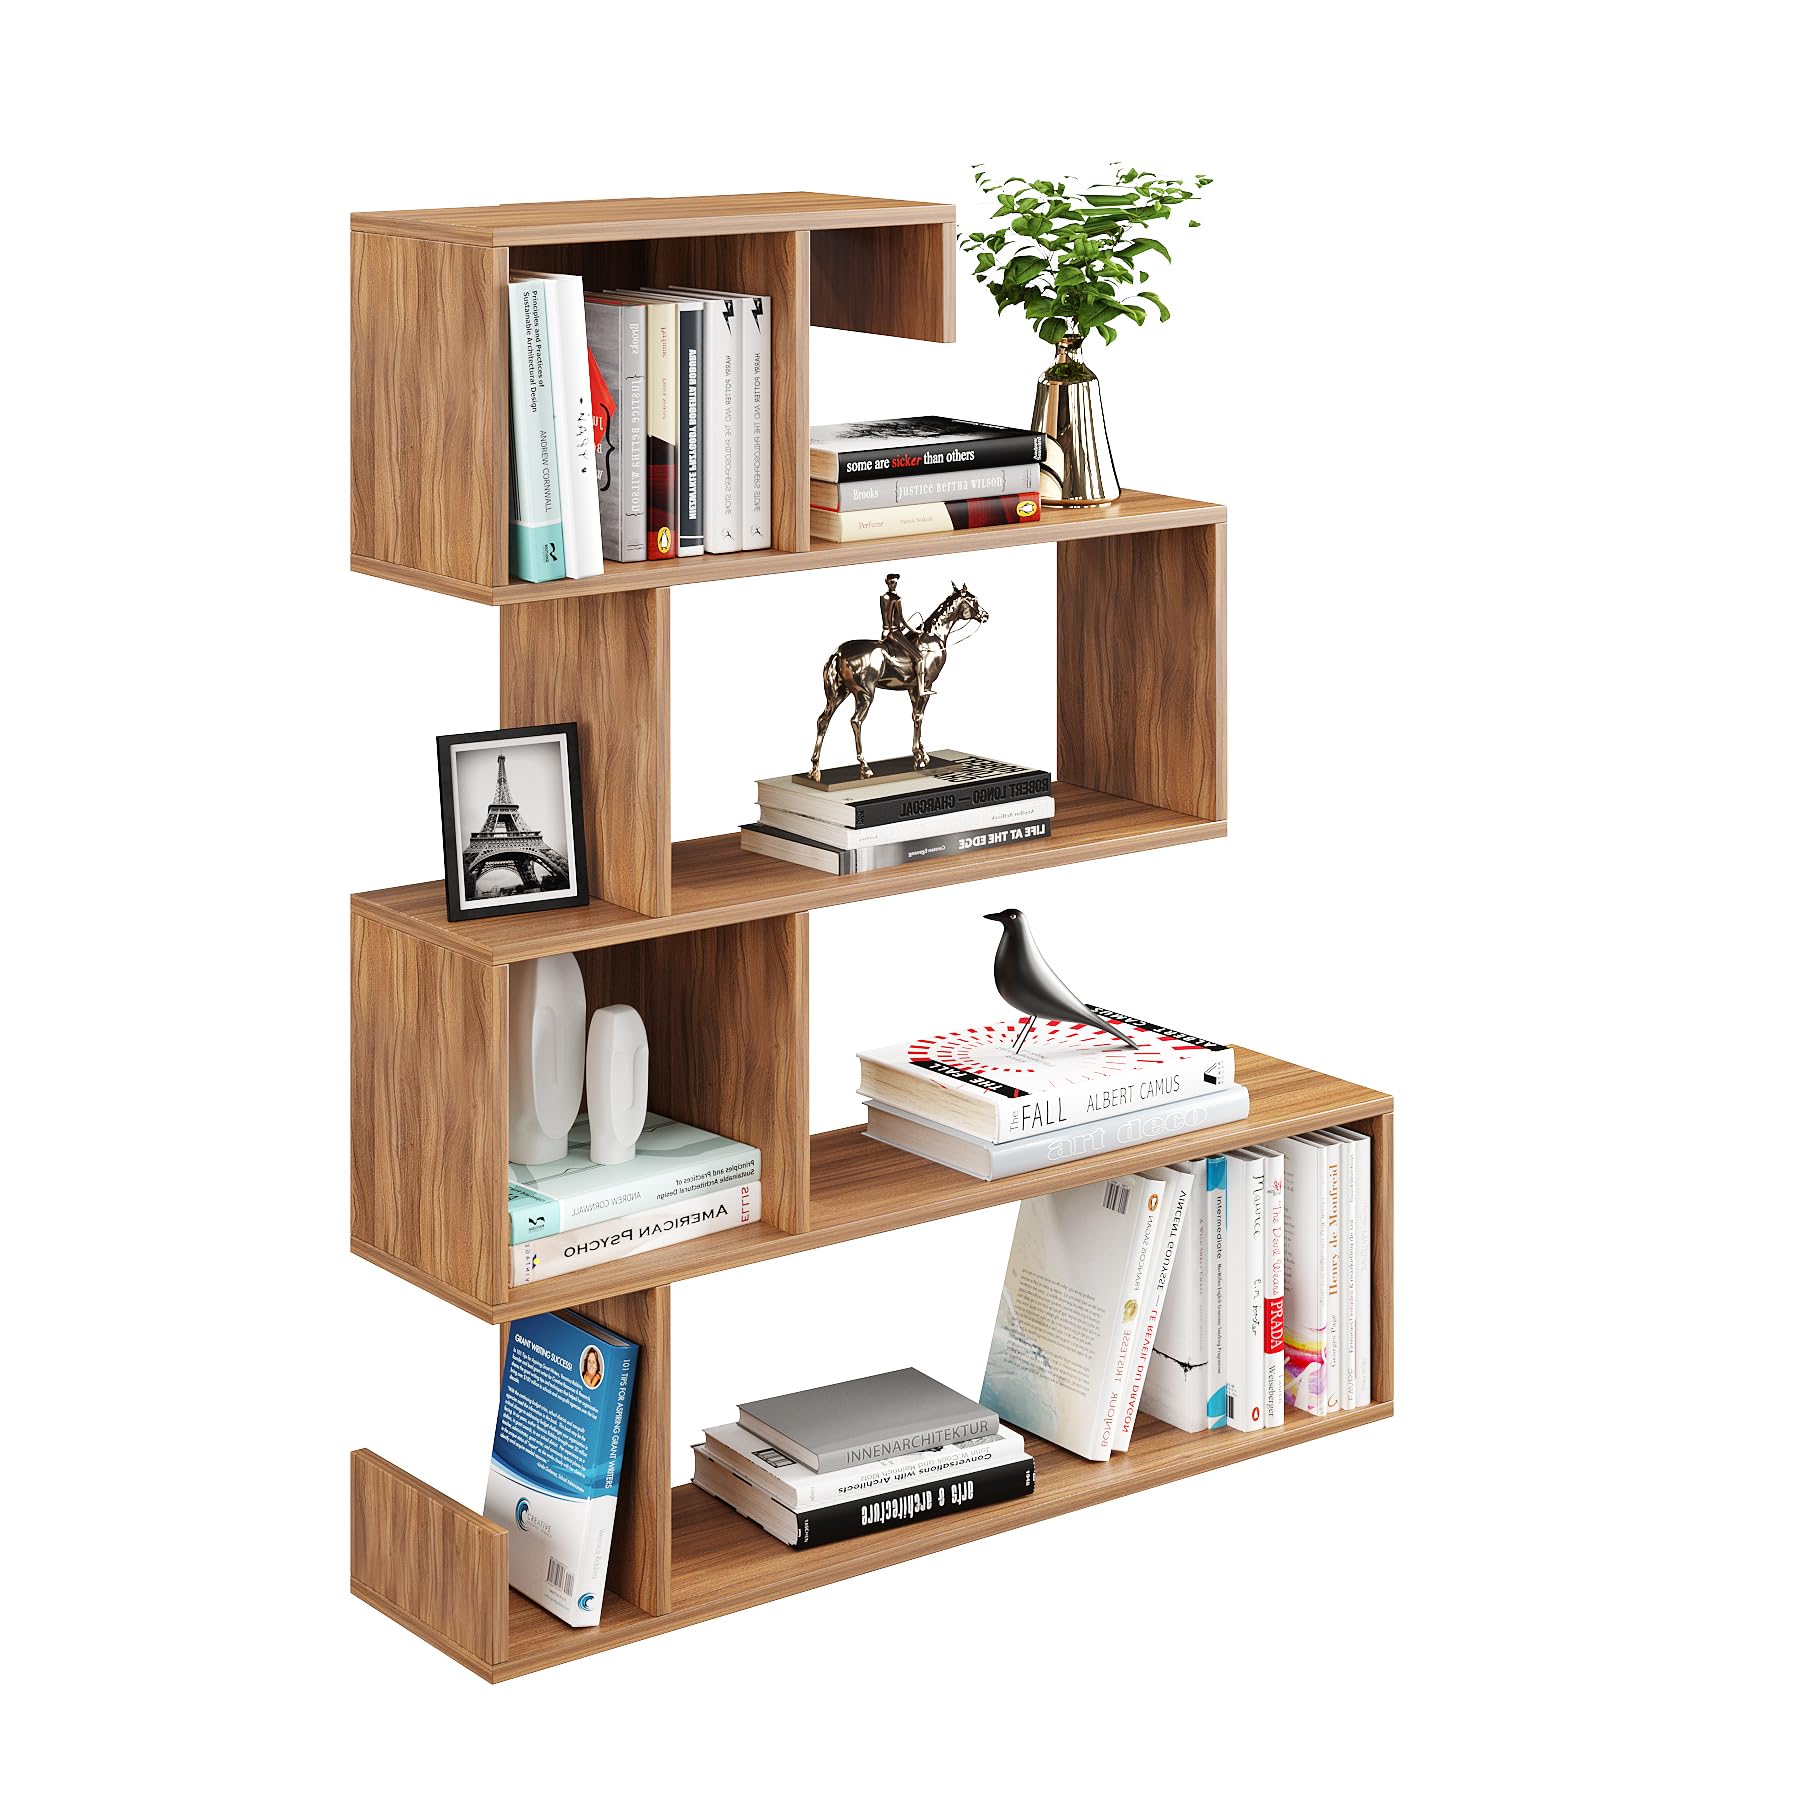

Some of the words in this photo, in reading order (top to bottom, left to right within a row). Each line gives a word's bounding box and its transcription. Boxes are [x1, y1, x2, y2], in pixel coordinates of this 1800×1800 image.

[523, 292, 532, 336] Sustainable
[532, 290, 542, 327] Principles
[527, 337, 536, 386] Architectural
[536, 344, 544, 376] Practices
[538, 377, 545, 387] of
[528, 387, 538, 412] Design
[540, 430, 549, 466] ANDREW
[846, 460, 872, 473] some
[874, 458, 890, 469] are
[892, 452, 922, 468] sicker
[924, 451, 945, 465] than
[947, 449, 975, 463] others
[542, 468, 552, 512] CORNWALL
[853, 489, 878, 501] Brooks
[1090, 1006, 1146, 1026] CAMUS
[1152, 1027, 1218, 1049] ALBERT
[927, 1063, 968, 1081] FALL
[971, 1077, 1003, 1091] THE
[1086, 1085, 1133, 1113] ALBERT
[1140, 1074, 1180, 1101] CAMUS
[1010, 1111, 1019, 1132] The
[1021, 1098, 1067, 1131] FALL
[1048, 1128, 1104, 1162] art
[1116, 1106, 1207, 1144] deco
[1253, 1175, 1264, 1240] Maurice
[1329, 1164, 1338, 1226] Monfreid
[1272, 1200, 1282, 1223] The
[1272, 1228, 1282, 1256] Devil
[1329, 1232, 1338, 1247] de
[1272, 1259, 1282, 1296] Wears
[1329, 1254, 1339, 1295] Henry
[1270, 1301, 1283, 1350] PRADA
[515, 1334, 531, 1348] GRANT
[531, 1341, 551, 1359] WRITING
[622, 1359, 630, 1370] 101
[620, 1373, 628, 1387] TIPS
[618, 1388, 626, 1401] FOR
[613, 1402, 624, 1434] ASPIRING
[609, 1435, 619, 1459] GRANT
[846, 1420, 988, 1464] INNENARCHITEKTUR
[605, 1460, 615, 1489] WRITERS
[894, 1470, 916, 1481] with
[918, 1453, 992, 1475] Conversations
[838, 1476, 890, 1494] Architects
[951, 1480, 974, 1503] arts
[861, 1488, 932, 1526] architecture
